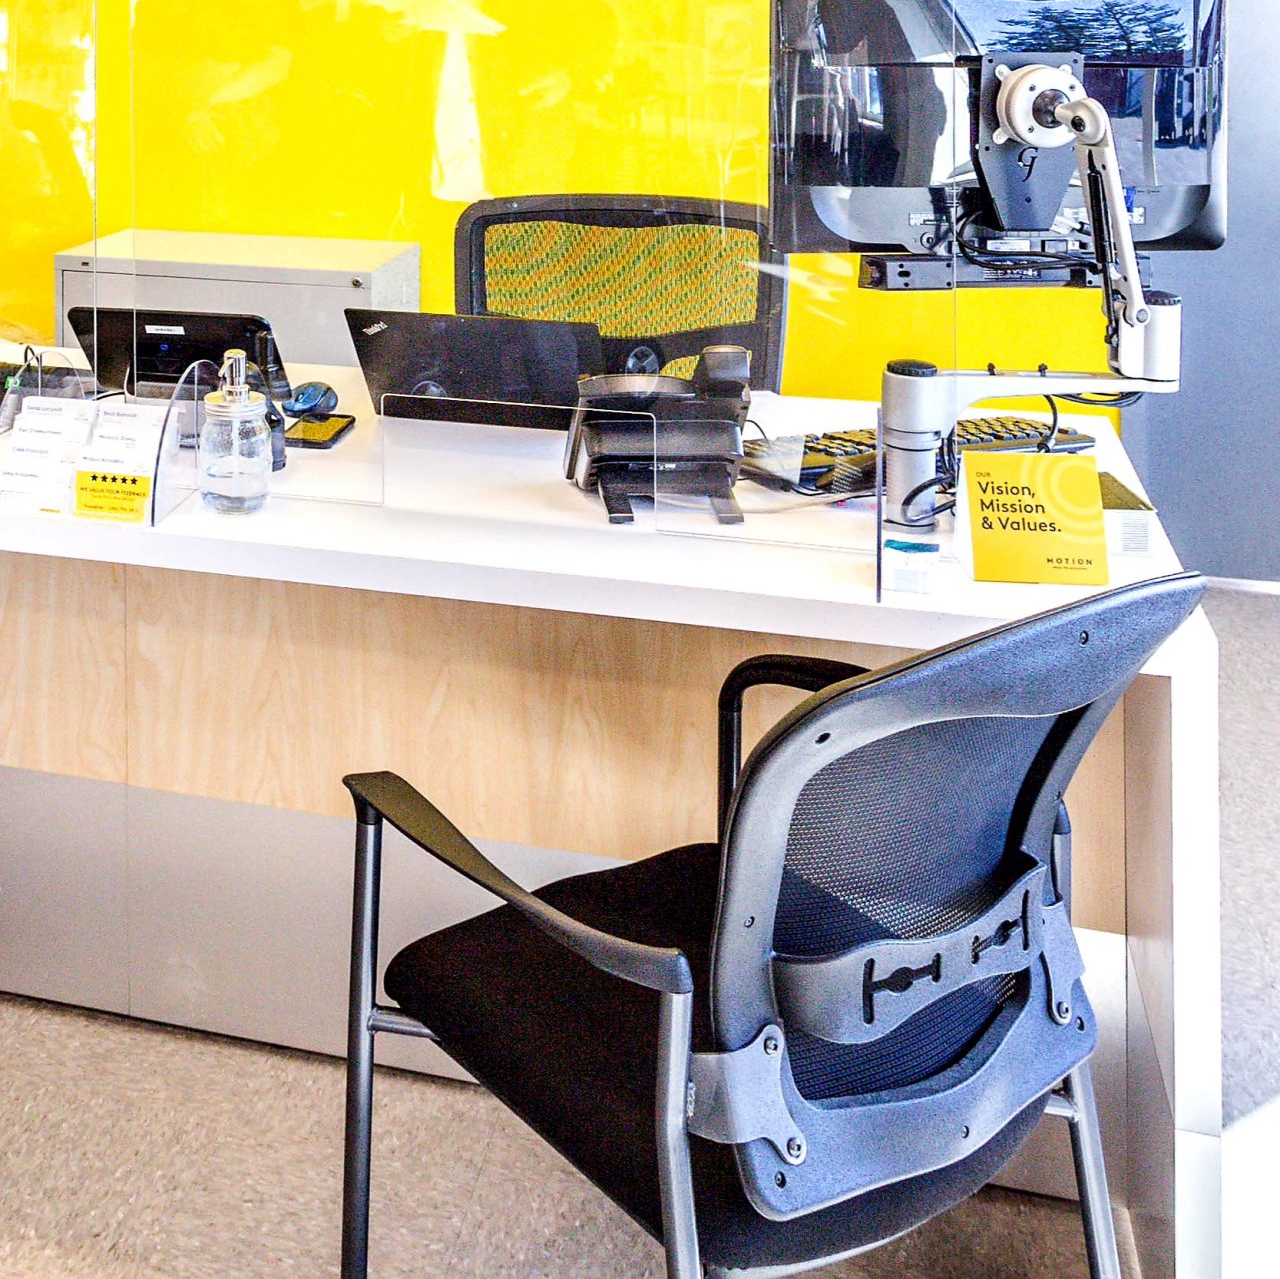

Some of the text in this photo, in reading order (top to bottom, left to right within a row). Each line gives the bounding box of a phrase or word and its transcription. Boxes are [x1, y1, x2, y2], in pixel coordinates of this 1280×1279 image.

[977, 480, 1035, 498] Vision,
[980, 499, 1045, 514] Mission
[981, 516, 1061, 532] & Values.
[1047, 557, 1093, 565] MOTION
